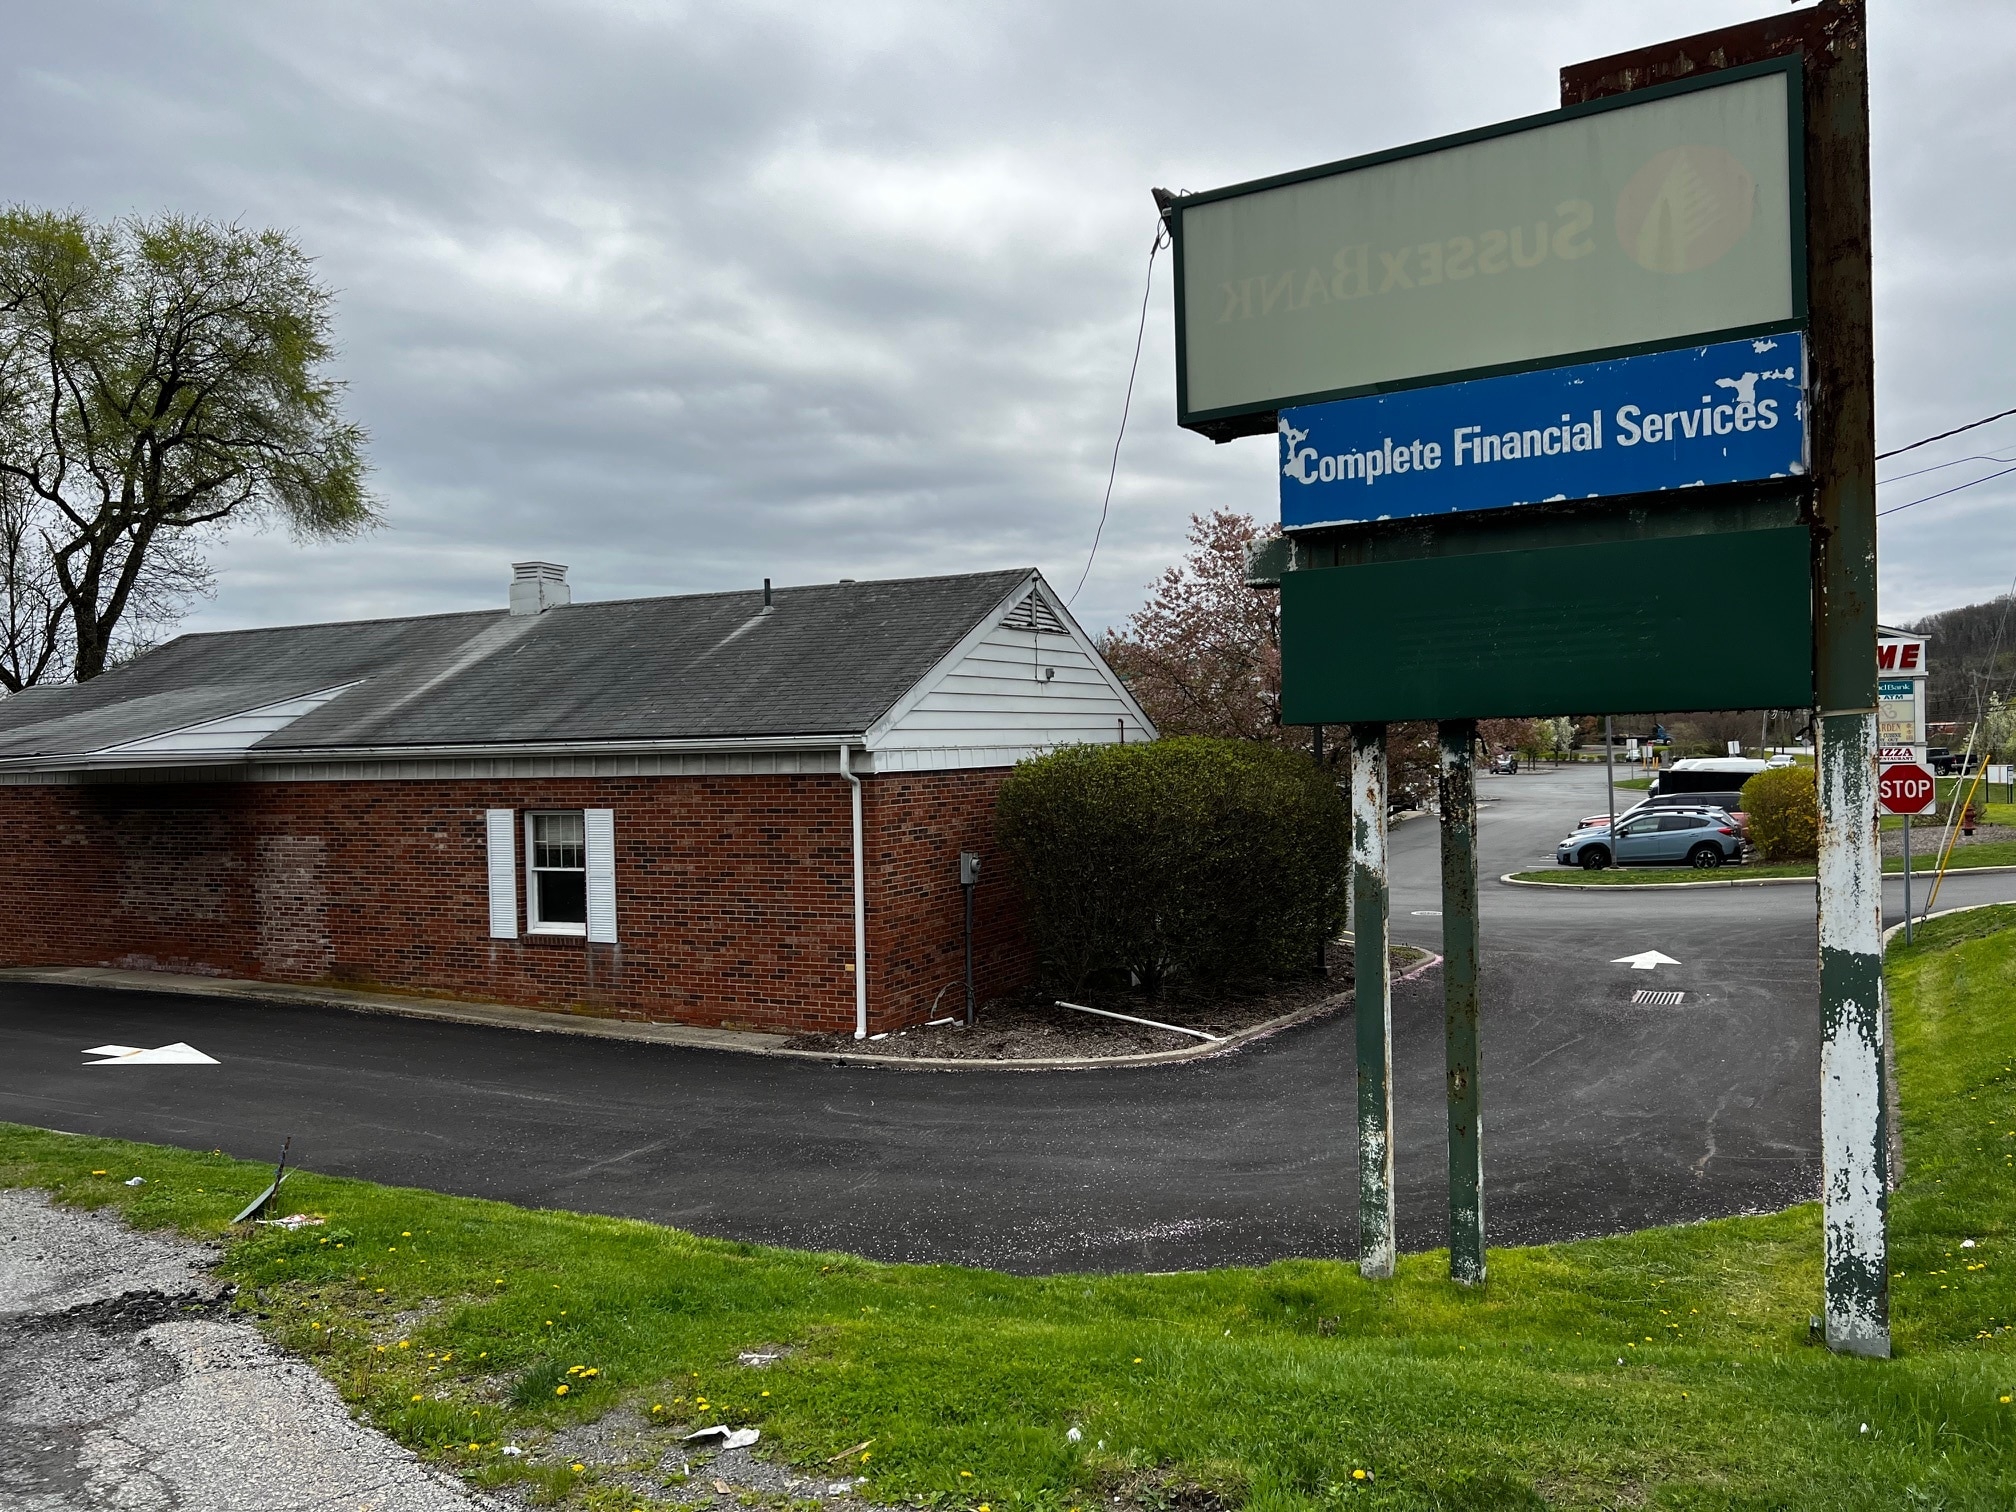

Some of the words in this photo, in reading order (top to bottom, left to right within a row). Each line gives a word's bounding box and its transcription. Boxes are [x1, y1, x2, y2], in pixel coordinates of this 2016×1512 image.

[1297, 438, 1443, 486] Complete
[1453, 409, 1603, 467] Financial
[1615, 395, 1779, 448] Services
[1887, 683, 1911, 691] Bank
[1880, 780, 1931, 799] STOP
